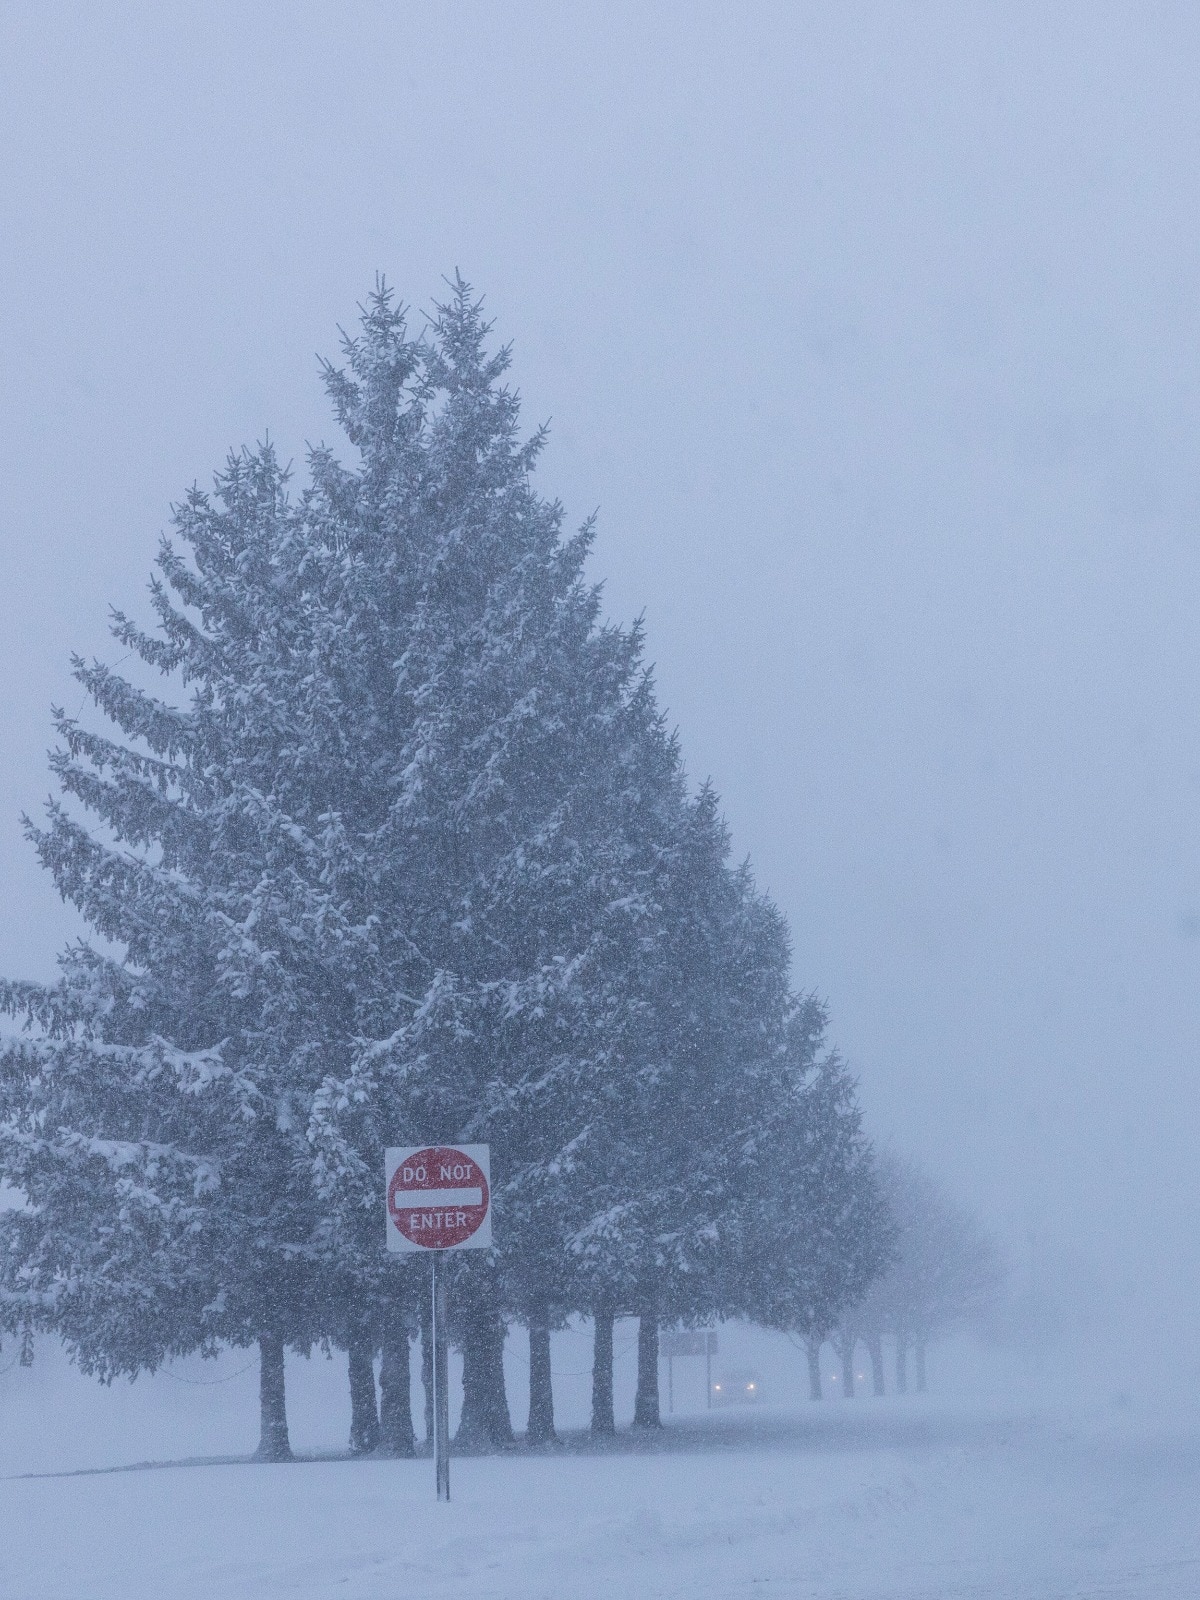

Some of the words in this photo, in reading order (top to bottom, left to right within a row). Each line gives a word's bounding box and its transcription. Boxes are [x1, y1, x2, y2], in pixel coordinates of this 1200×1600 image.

[403, 1167, 427, 1182] DO
[440, 1164, 473, 1180] NOT
[410, 1212, 467, 1229] ENTER
